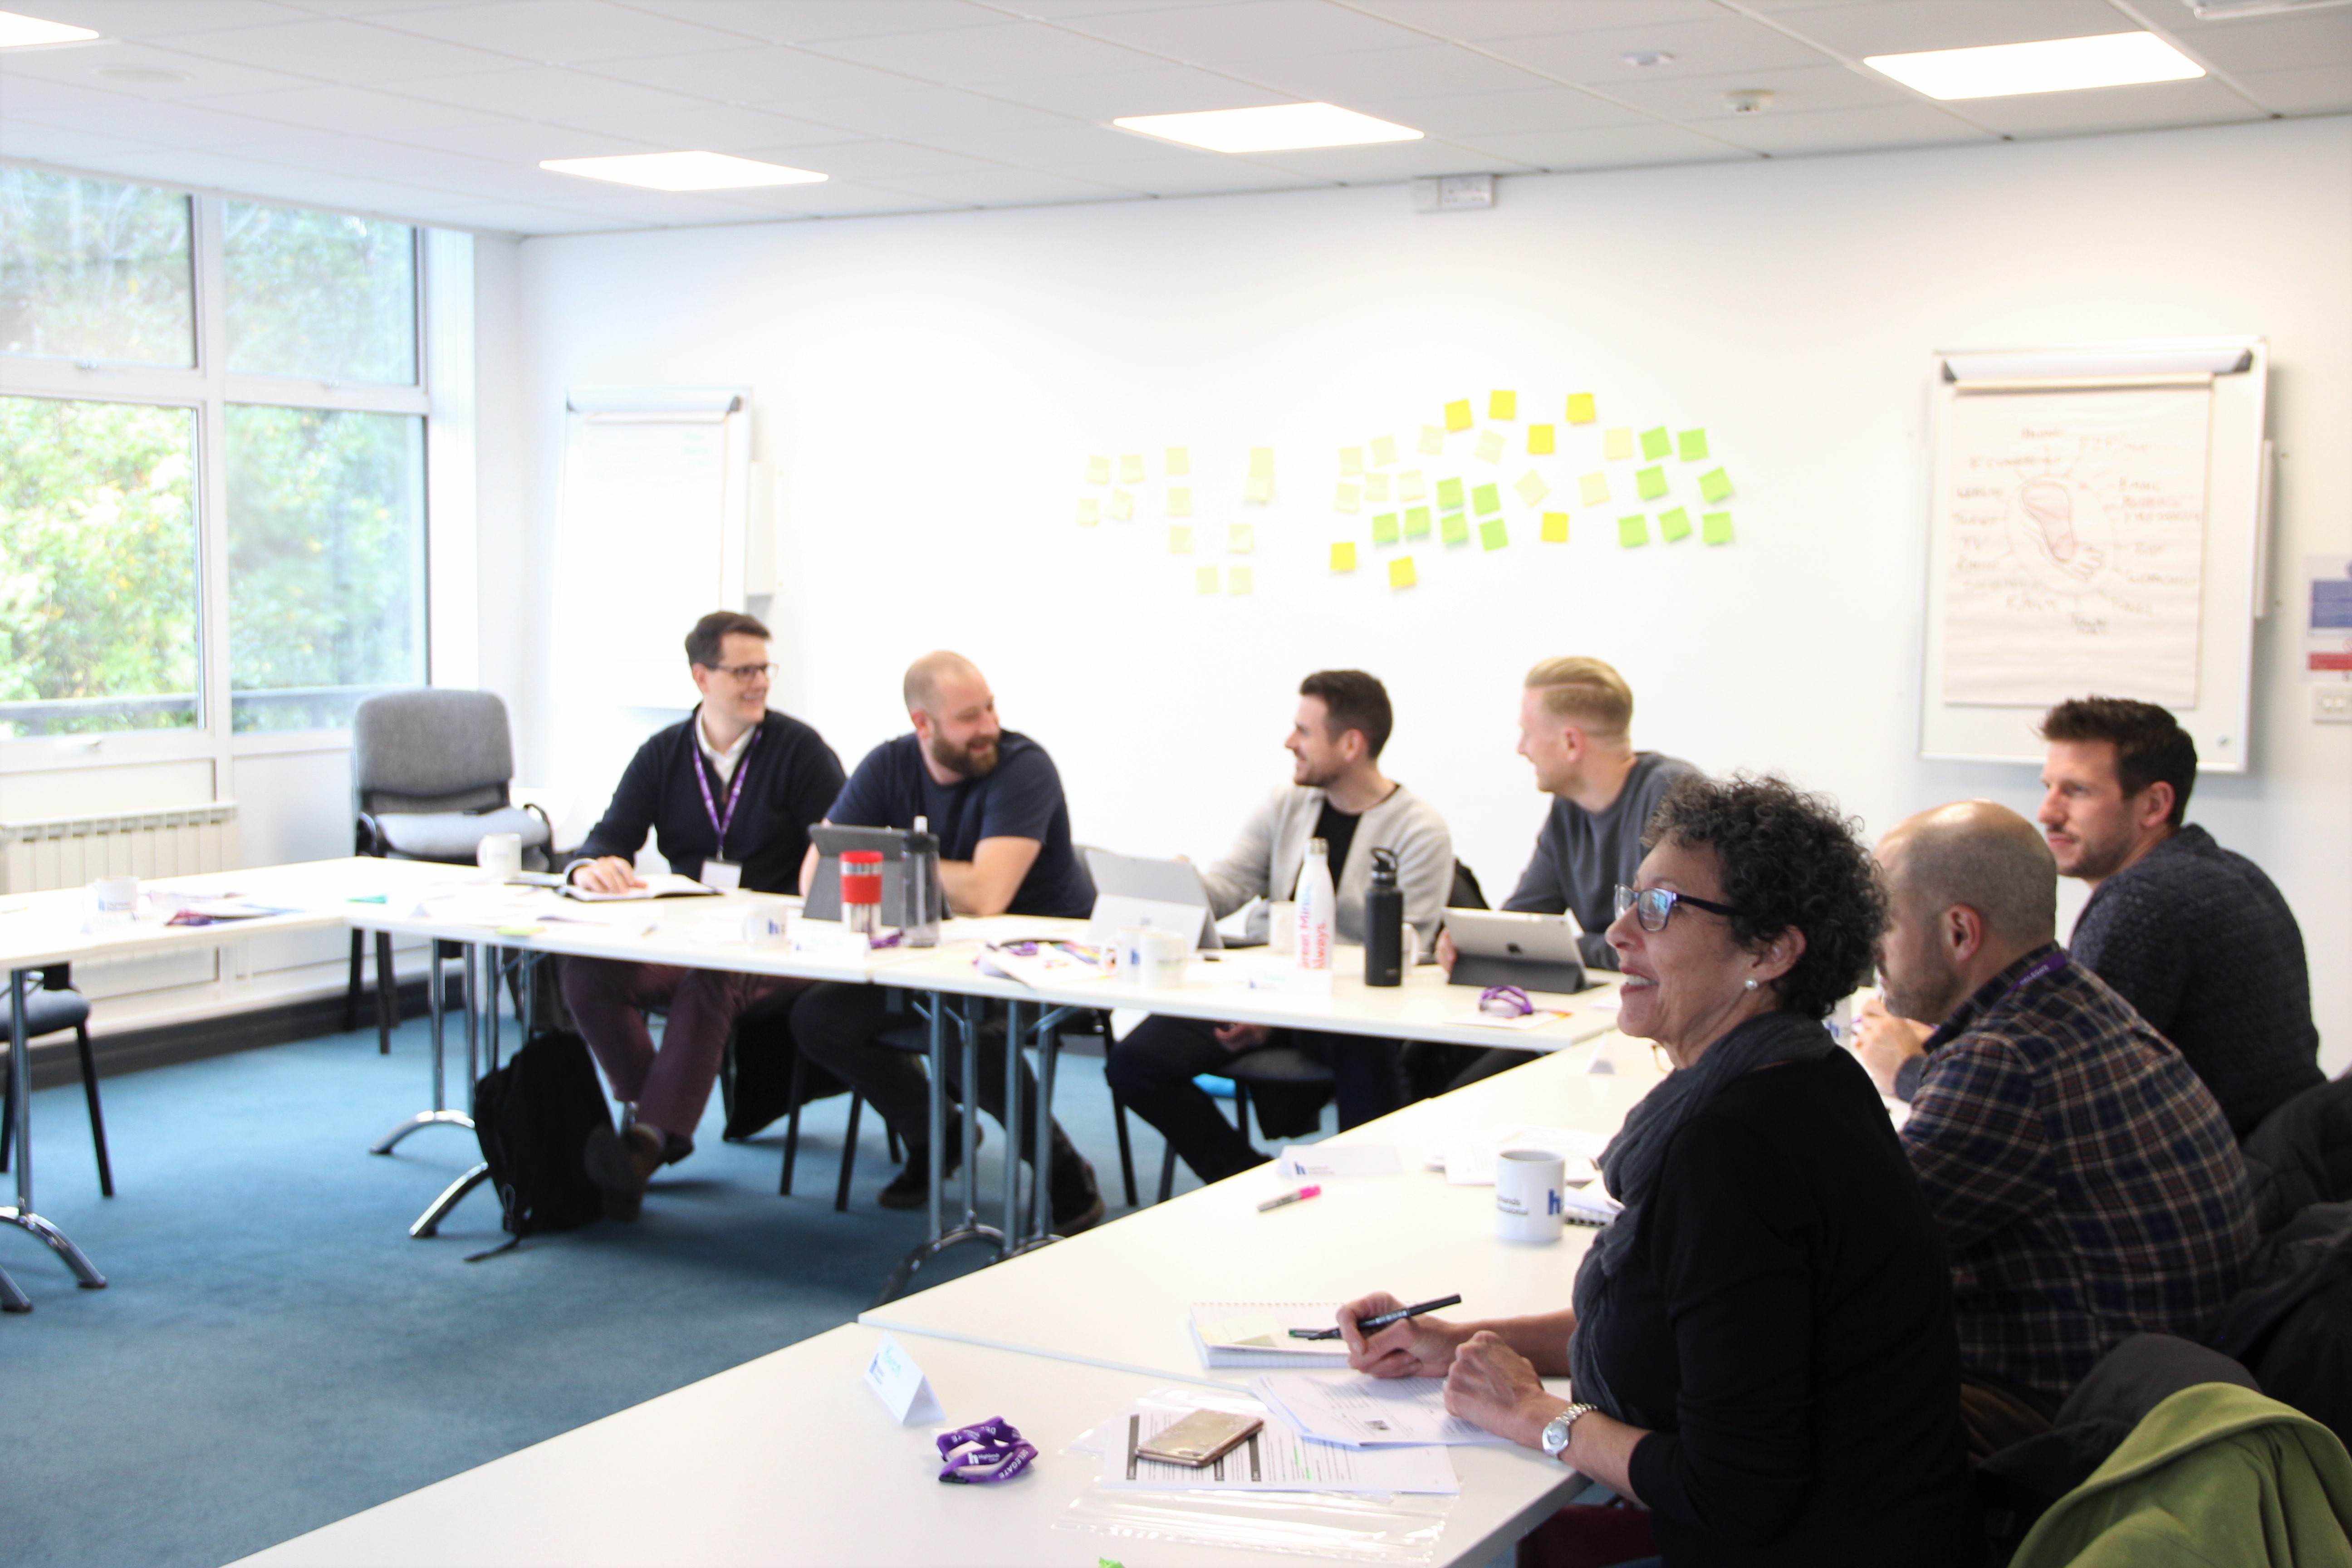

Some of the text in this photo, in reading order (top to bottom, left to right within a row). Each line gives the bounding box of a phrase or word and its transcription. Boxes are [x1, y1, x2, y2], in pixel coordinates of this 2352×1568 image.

[1548, 1188, 1561, 1215] h
[968, 1452, 980, 1465] h
[999, 1449, 1029, 1479] DELEGATE
